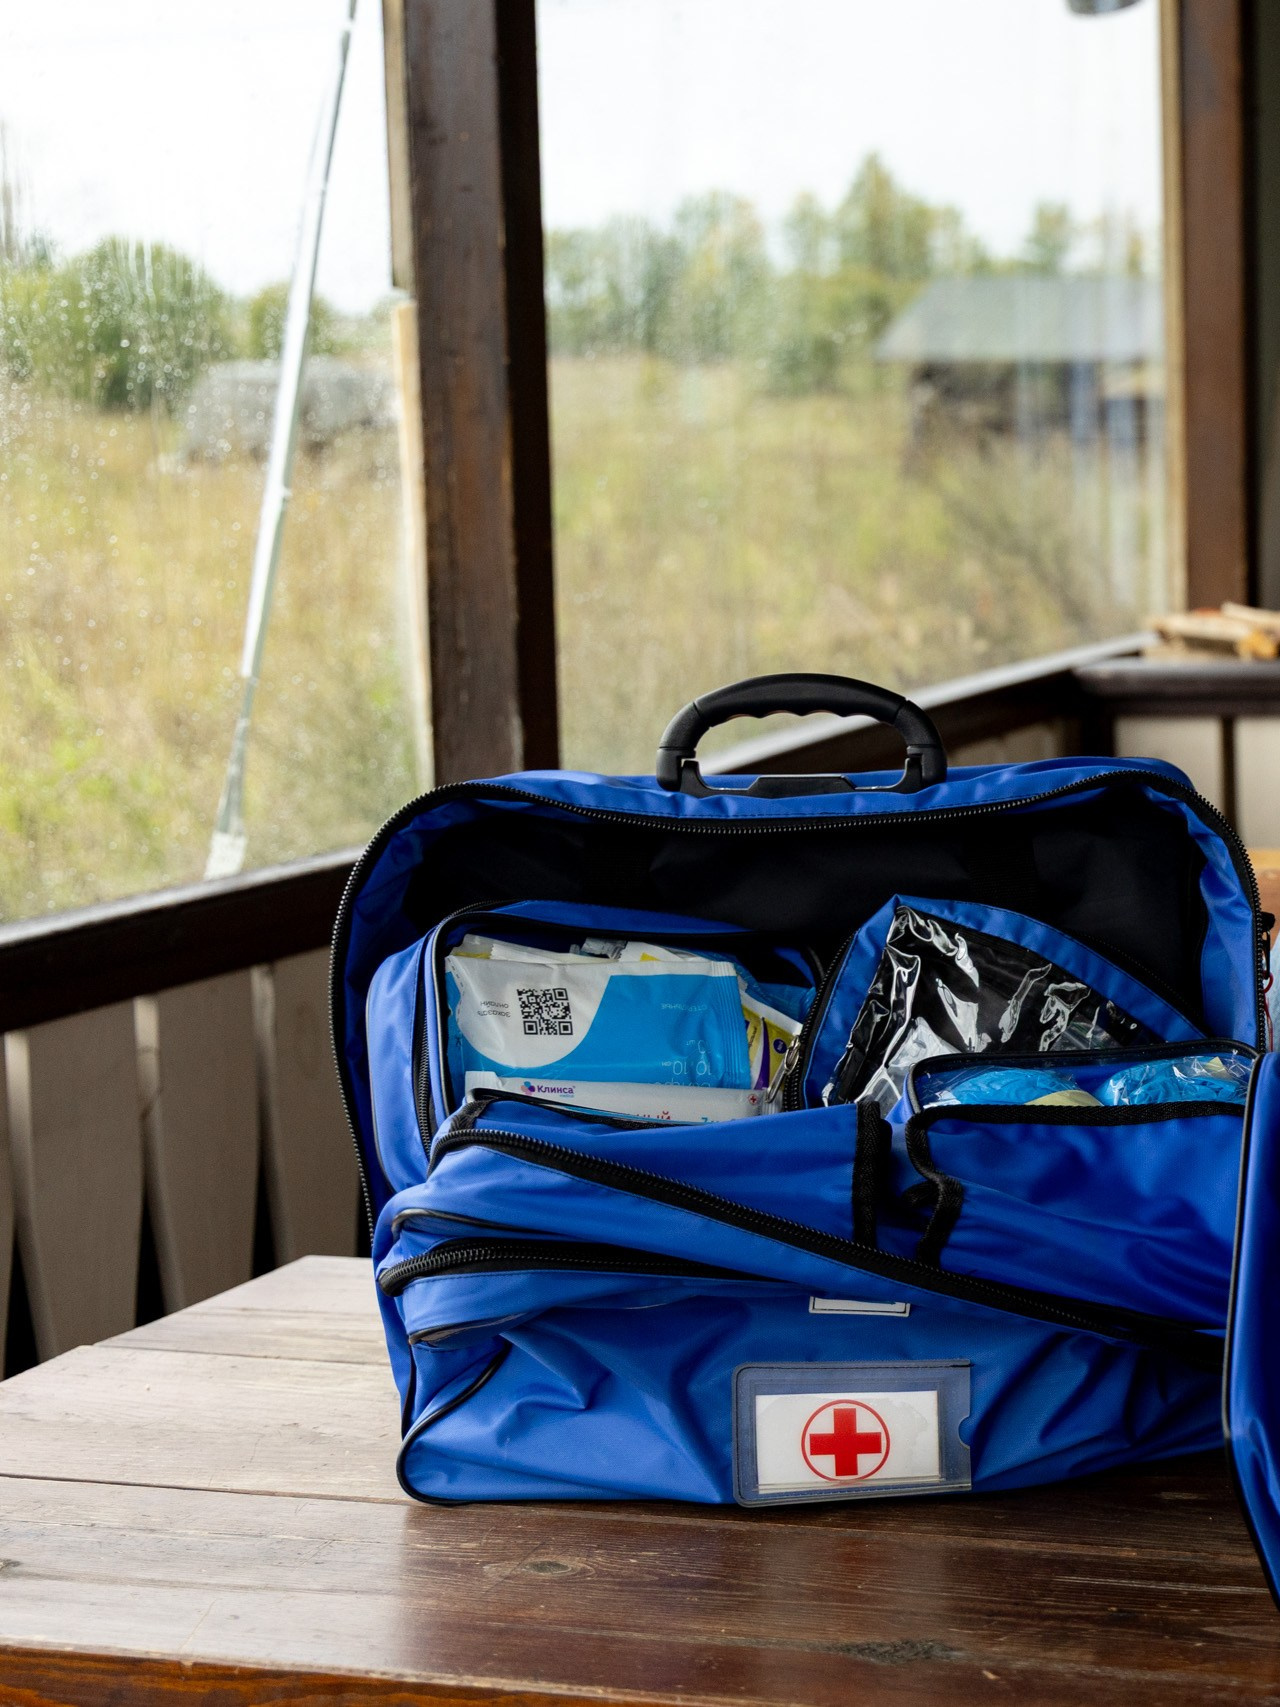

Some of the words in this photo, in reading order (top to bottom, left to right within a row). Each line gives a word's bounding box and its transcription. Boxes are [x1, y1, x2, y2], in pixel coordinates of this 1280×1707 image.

[659, 1003, 708, 1012] СТЕРЛЬНЫЕ
[673, 1060, 688, 1075] 10
[537, 1085, 574, 1094] Клинса
